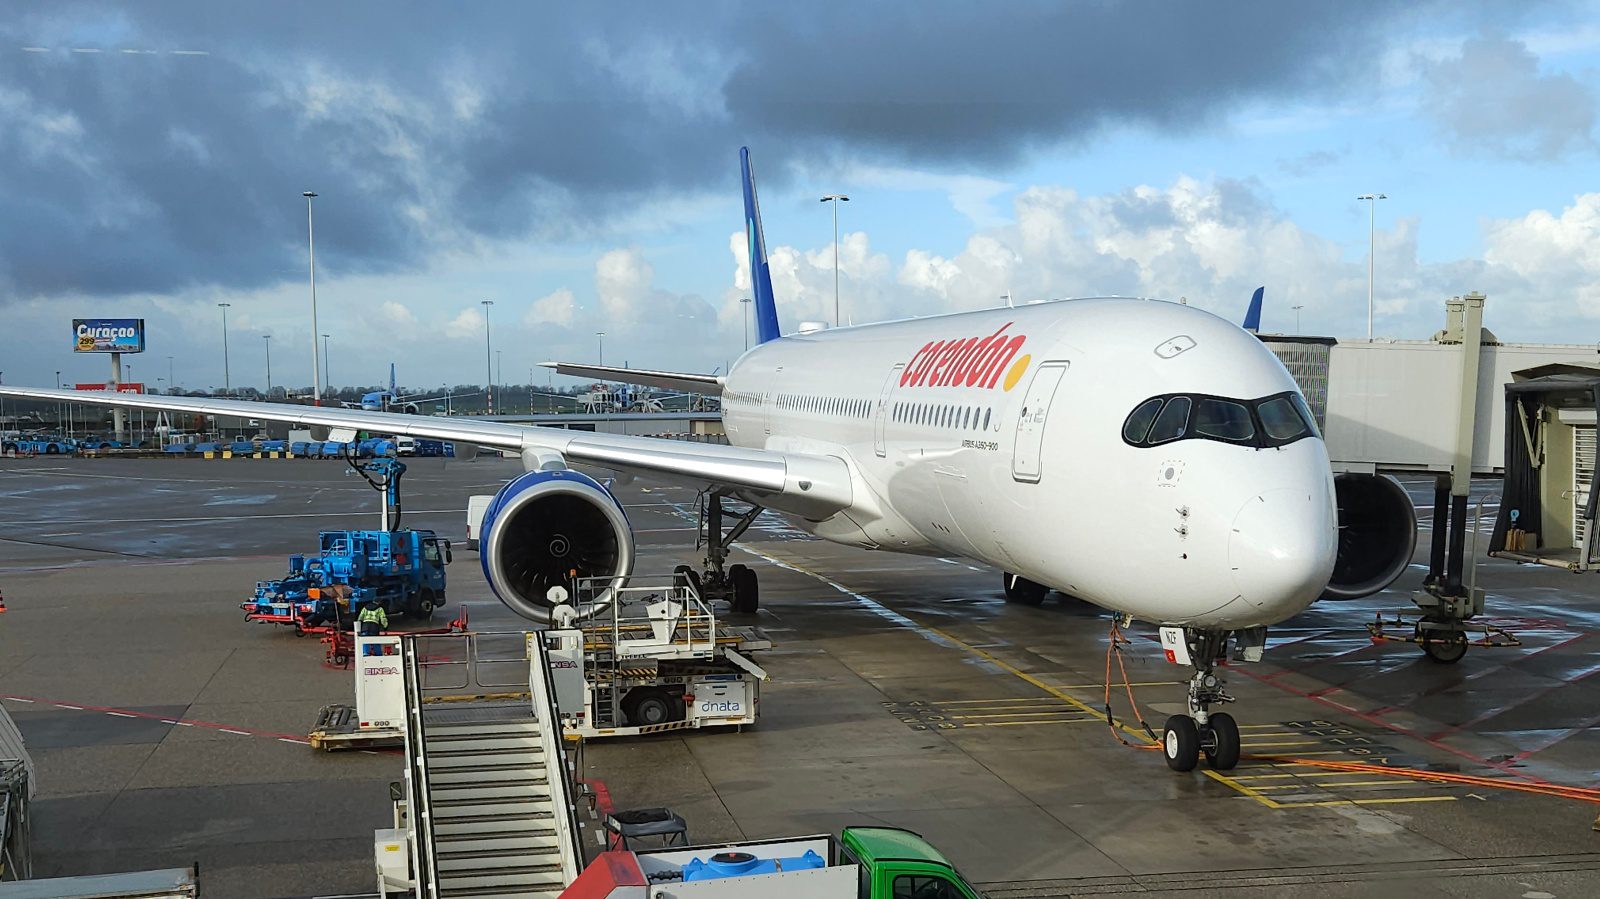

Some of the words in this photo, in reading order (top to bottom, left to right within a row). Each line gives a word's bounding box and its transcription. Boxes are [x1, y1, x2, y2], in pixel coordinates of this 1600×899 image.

[77, 324, 135, 341] Curaçao
[899, 321, 1026, 389] corendon
[364, 667, 400, 675] EINSA
[702, 701, 740, 712] dnata
